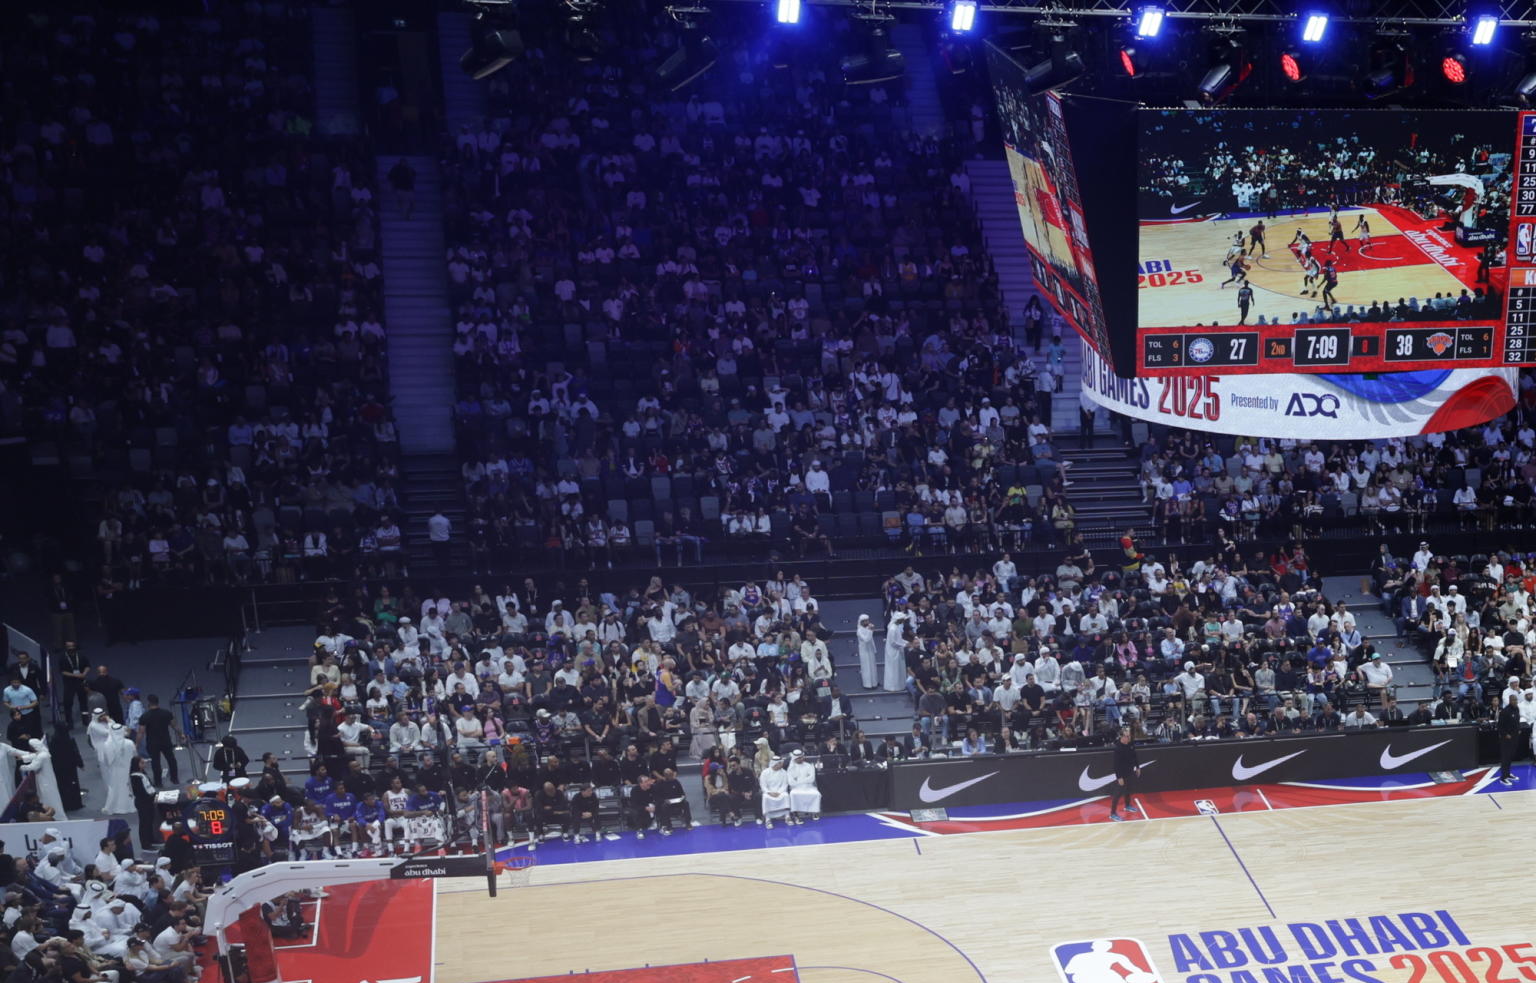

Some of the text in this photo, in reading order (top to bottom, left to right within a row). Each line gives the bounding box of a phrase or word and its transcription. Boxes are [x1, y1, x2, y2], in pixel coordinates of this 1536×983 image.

[1528, 149, 1536, 159] 9
[1525, 163, 1536, 173] 11
[1523, 177, 1536, 187] 25
[1522, 191, 1535, 201] 30
[1521, 204, 1534, 214] 77
[1516, 300, 1522, 309] 5
[1512, 313, 1523, 322] 11
[1510, 326, 1523, 336] 25
[1148, 341, 1163, 349] TOL
[1271, 342, 1286, 356] 2ND
[1307, 335, 1338, 359] 7:09
[1395, 334, 1414, 356] 38
[1509, 339, 1522, 349] 28
[1230, 339, 1247, 360] 27
[1172, 354, 1179, 362] 3
[1508, 352, 1521, 362] 32
[1231, 392, 1340, 418] Presented by ADQ
[199, 810, 225, 821] 7:09
[212, 821, 222, 834] 8
[1168, 909, 1472, 973] ABU DHABI
